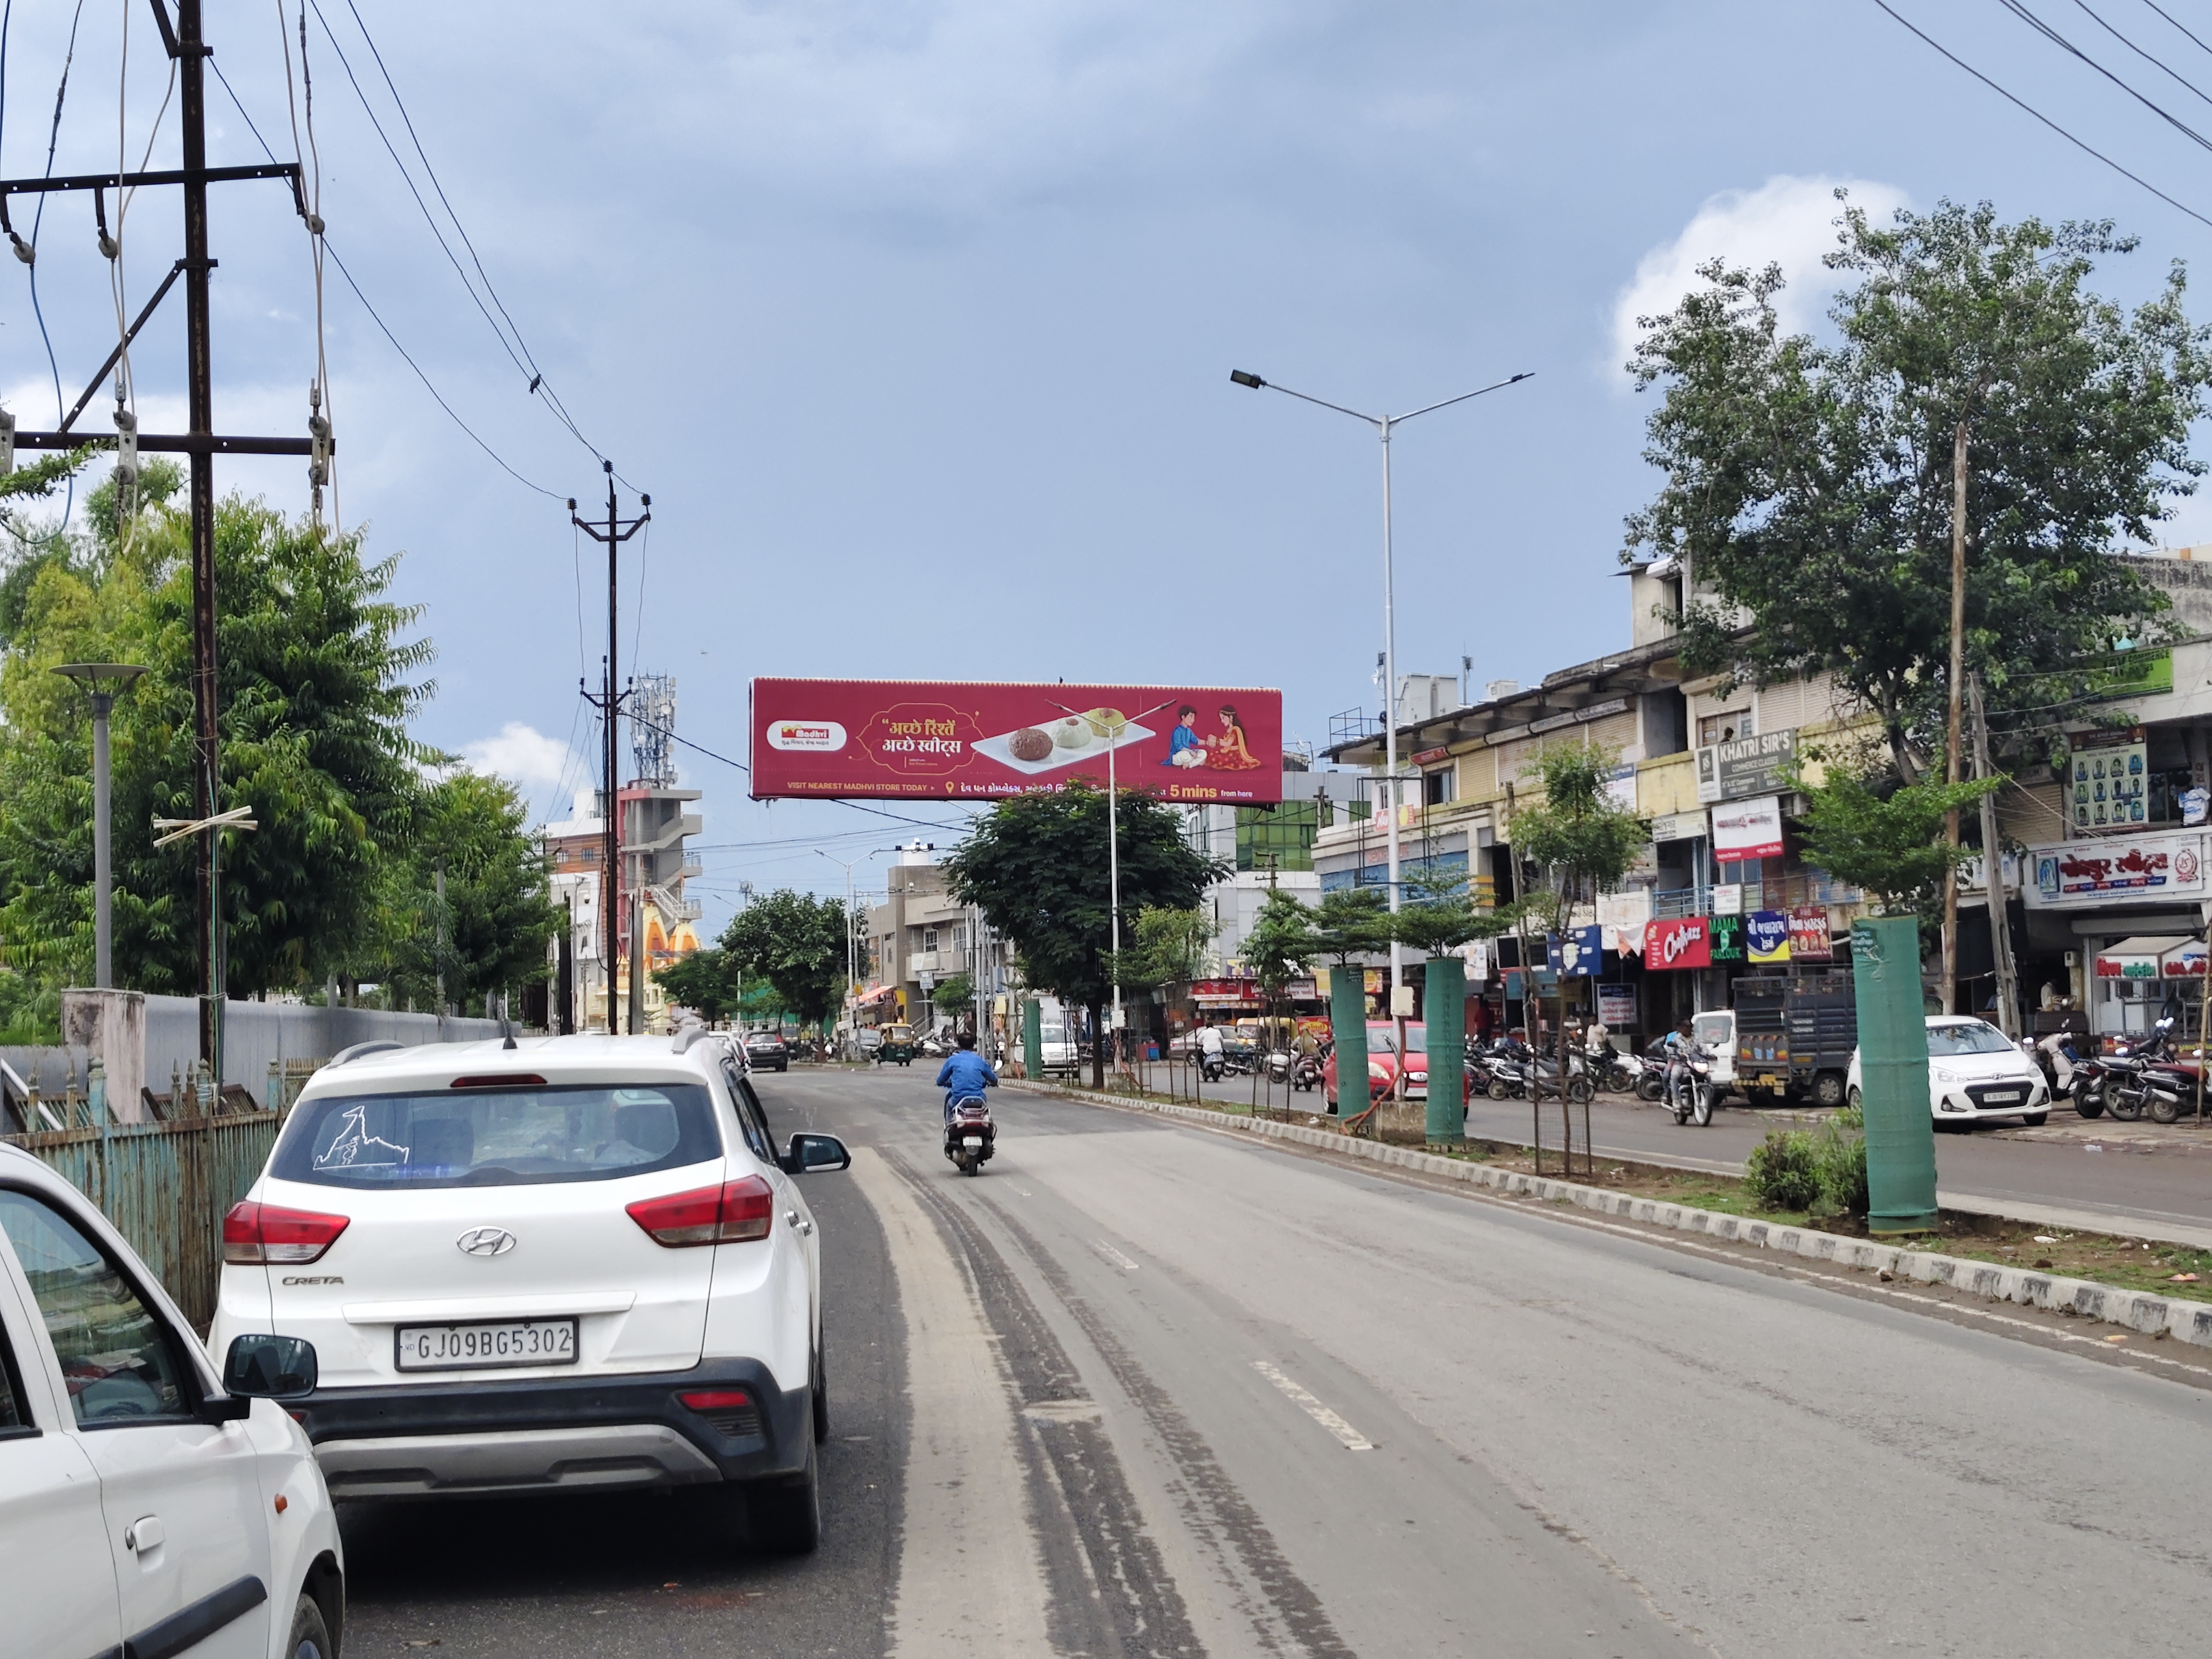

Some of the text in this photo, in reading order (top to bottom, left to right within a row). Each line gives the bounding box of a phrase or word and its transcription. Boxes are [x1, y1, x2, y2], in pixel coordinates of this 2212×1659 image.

[795, 730, 827, 738] Madhvi
[882, 736, 962, 757] अच्छे स्वीट्स
[1719, 731, 1790, 763] KHATRI SIR'S
[1170, 784, 1179, 797] 5
[1182, 784, 1217, 798] mins
[1709, 917, 1738, 933] MAMA
[282, 1276, 344, 1285] CRETA
[418, 1327, 570, 1358] GJ09BG5302
